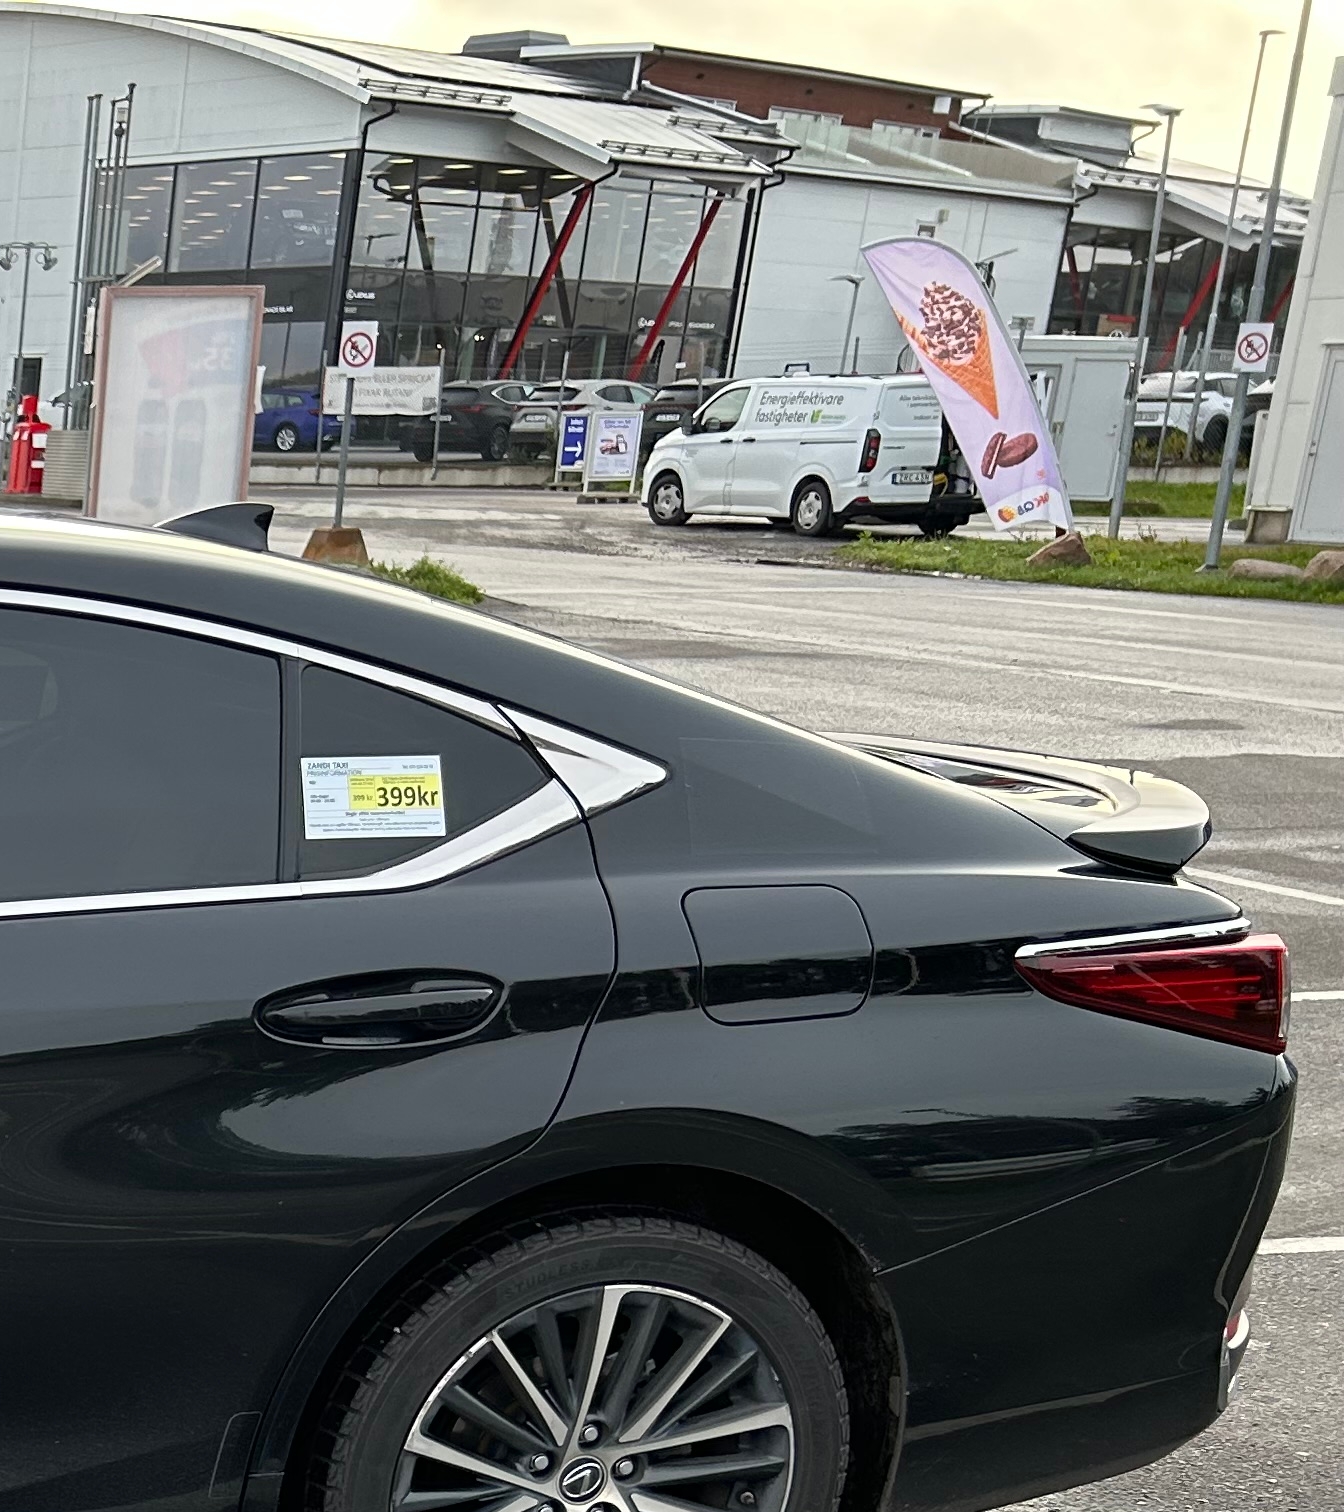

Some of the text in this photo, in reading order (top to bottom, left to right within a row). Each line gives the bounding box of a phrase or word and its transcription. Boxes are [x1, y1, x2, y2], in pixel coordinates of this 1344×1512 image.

[760, 391, 844, 408] Energieffektivare
[755, 408, 808, 426] fastigheter
[352, 793, 374, 802] 399 kr
[376, 785, 439, 807] 399kr
